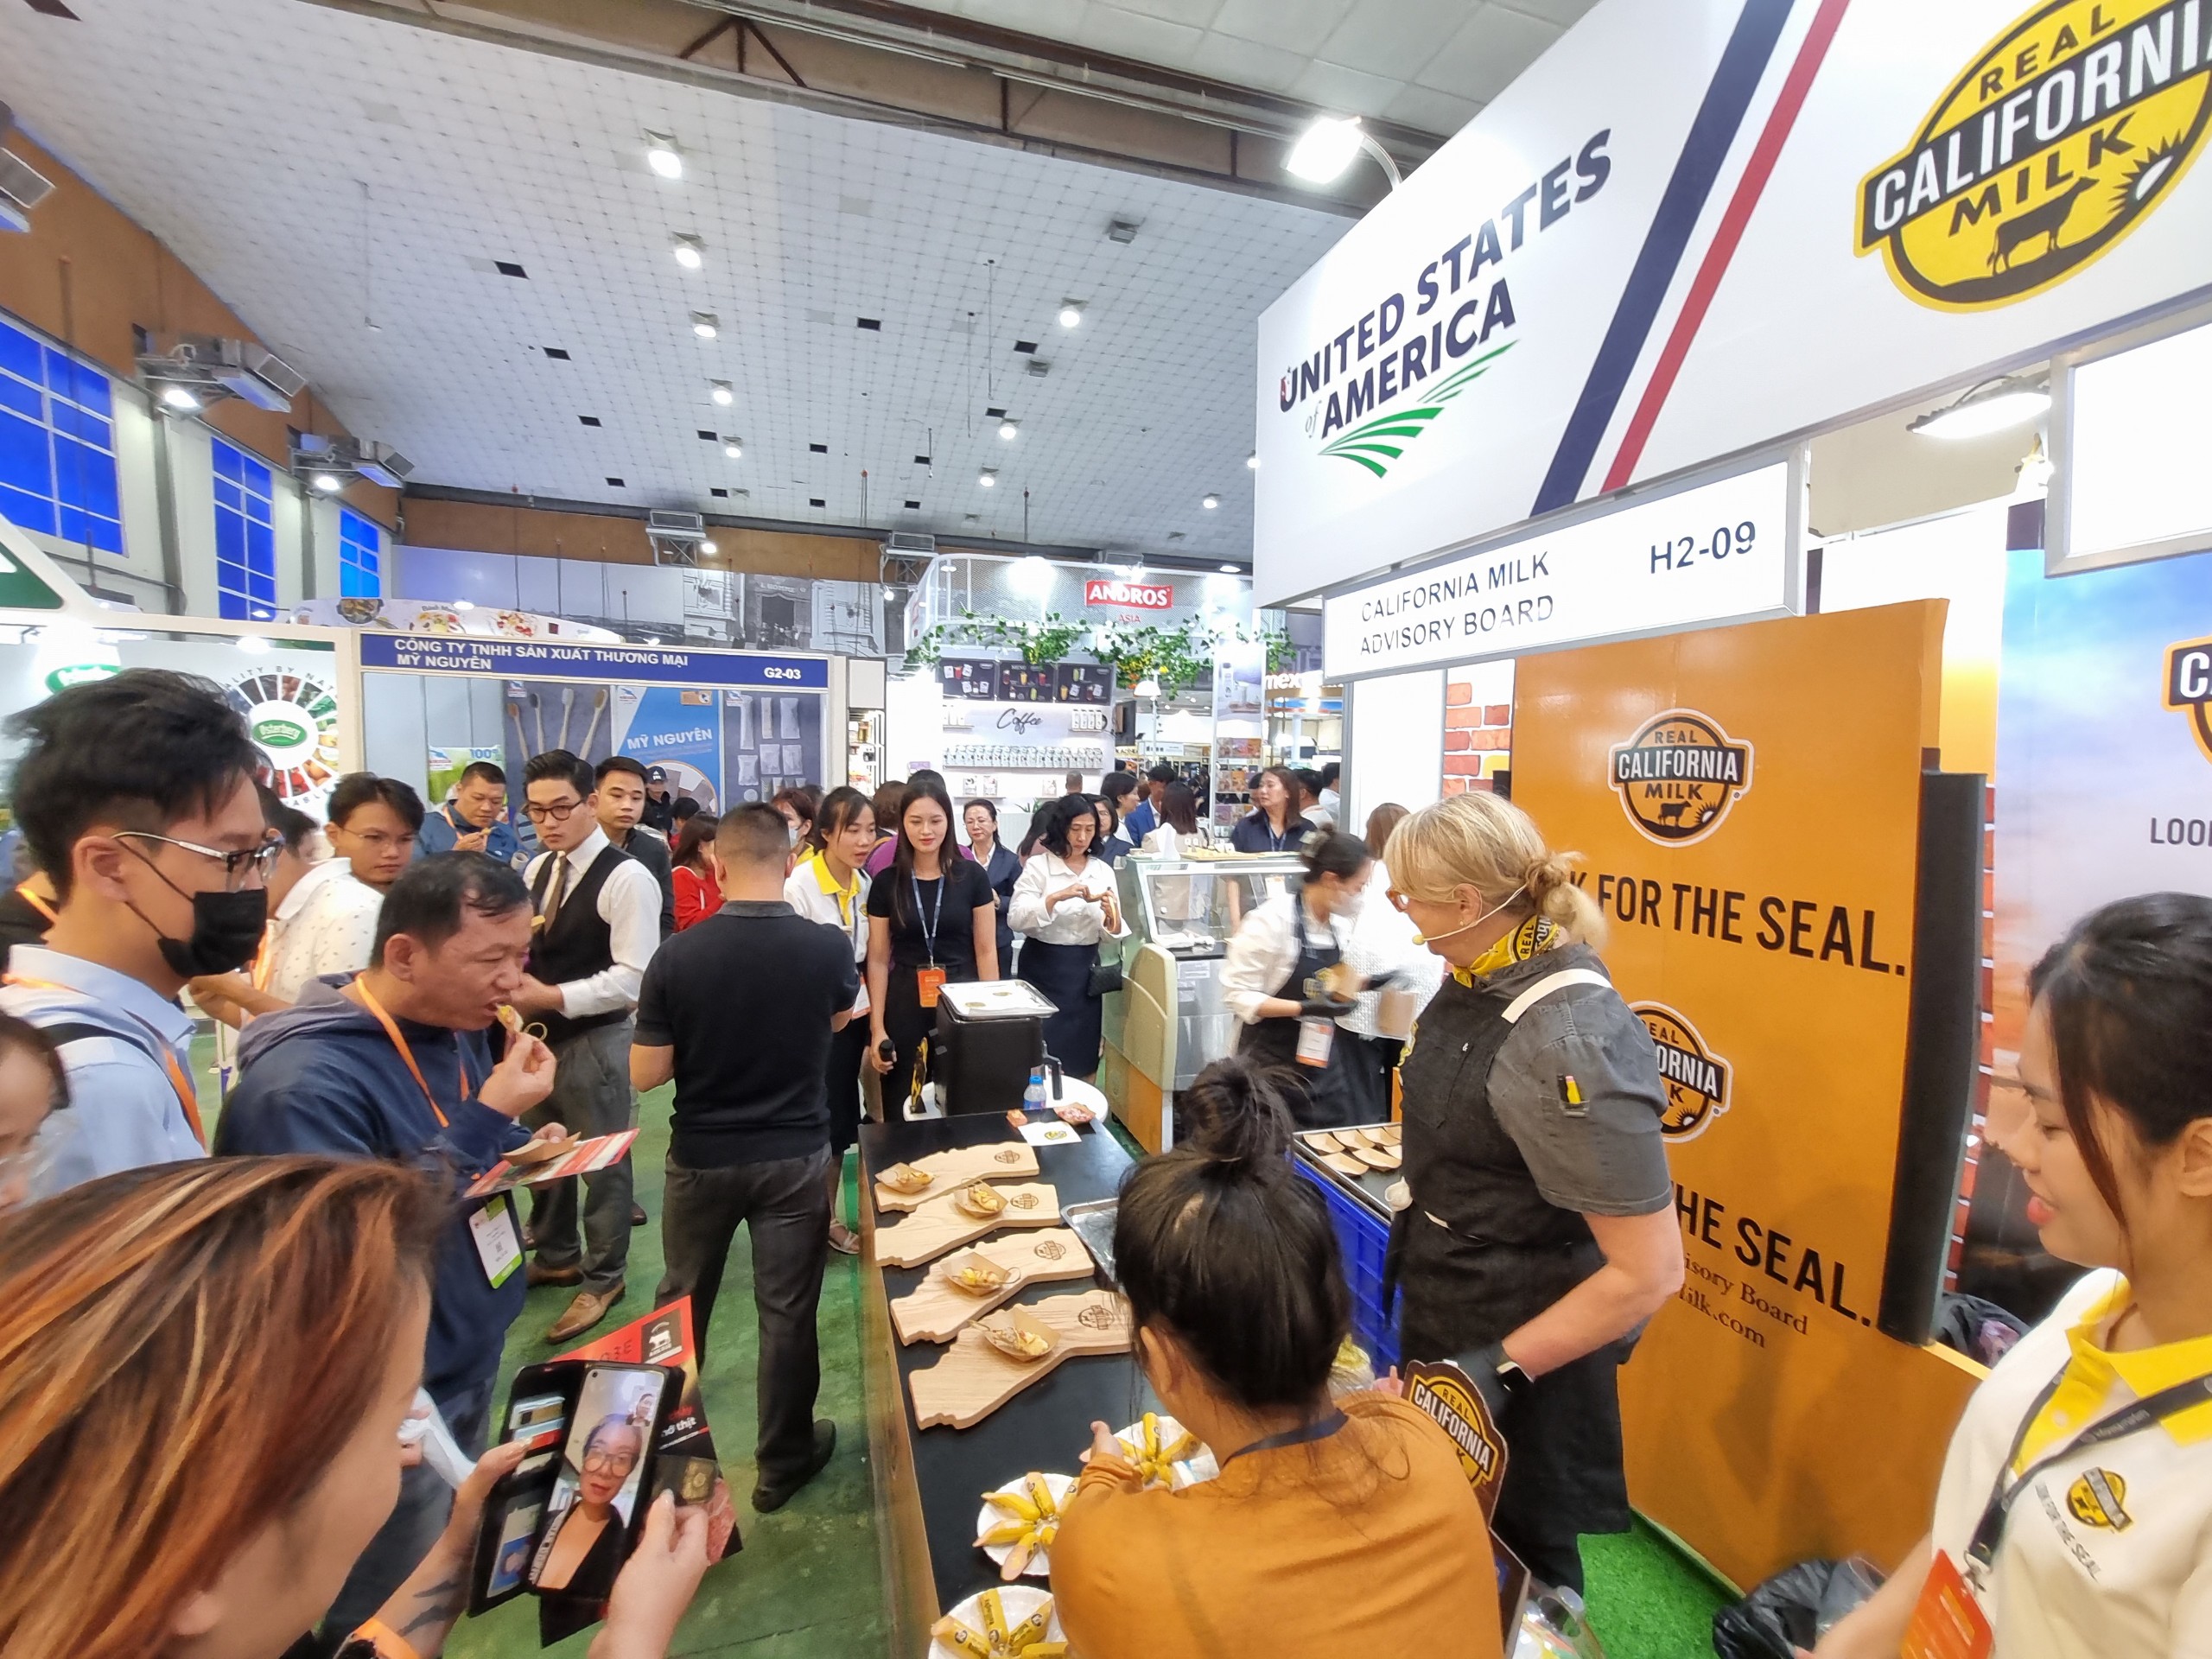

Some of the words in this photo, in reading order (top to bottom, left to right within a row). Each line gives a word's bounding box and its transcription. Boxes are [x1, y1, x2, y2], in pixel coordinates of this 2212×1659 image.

[1979, 3, 2116, 103] REAL
[1873, 0, 2212, 232] CALIFORNI
[1948, 111, 2138, 238] MILK
[1279, 292, 1405, 413] UNITED
[1416, 127, 1611, 316] STATES
[1305, 399, 1323, 438] of
[1321, 276, 1517, 440] AMERICA
[1649, 520, 1757, 575] H2-09
[1089, 584, 1167, 607] ANDROS
[1361, 572, 1479, 623] CALIFORNIA
[1487, 551, 1550, 591] MILK
[1360, 615, 1456, 657] ADVISORY
[1464, 594, 1554, 637] BOARD
[394, 637, 442, 653] CÔNG
[446, 641, 466, 655] TY
[469, 643, 512, 658] TNHH
[595, 649, 659, 665] THƯƠNG
[662, 654, 689, 669] MẠI
[424, 654, 492, 671] NGUYÊN
[763, 666, 802, 680] G2-03
[652, 727, 713, 747] NGUYÊN
[996, 708, 1044, 735] Coffee
[1654, 730, 1698, 744] REAL
[1618, 748, 1739, 783] CALIFORNIA
[1644, 782, 1704, 801] MILK
[1519, 925, 1535, 955] REAL
[1597, 873, 1662, 928] FOR
[1671, 882, 1746, 944] THE
[1755, 895, 1906, 977] SEAL.
[1641, 1019, 1680, 1045] EAL
[1656, 1045, 1719, 1098] ORNIA
[1673, 1180, 1725, 1250] HE
[1733, 1217, 1872, 1328] SEAL.
[1739, 1281, 1808, 1336] Board
[1414, 1383, 1491, 1472] CALIFORNIA
[1442, 1388, 1470, 1421] REAL
